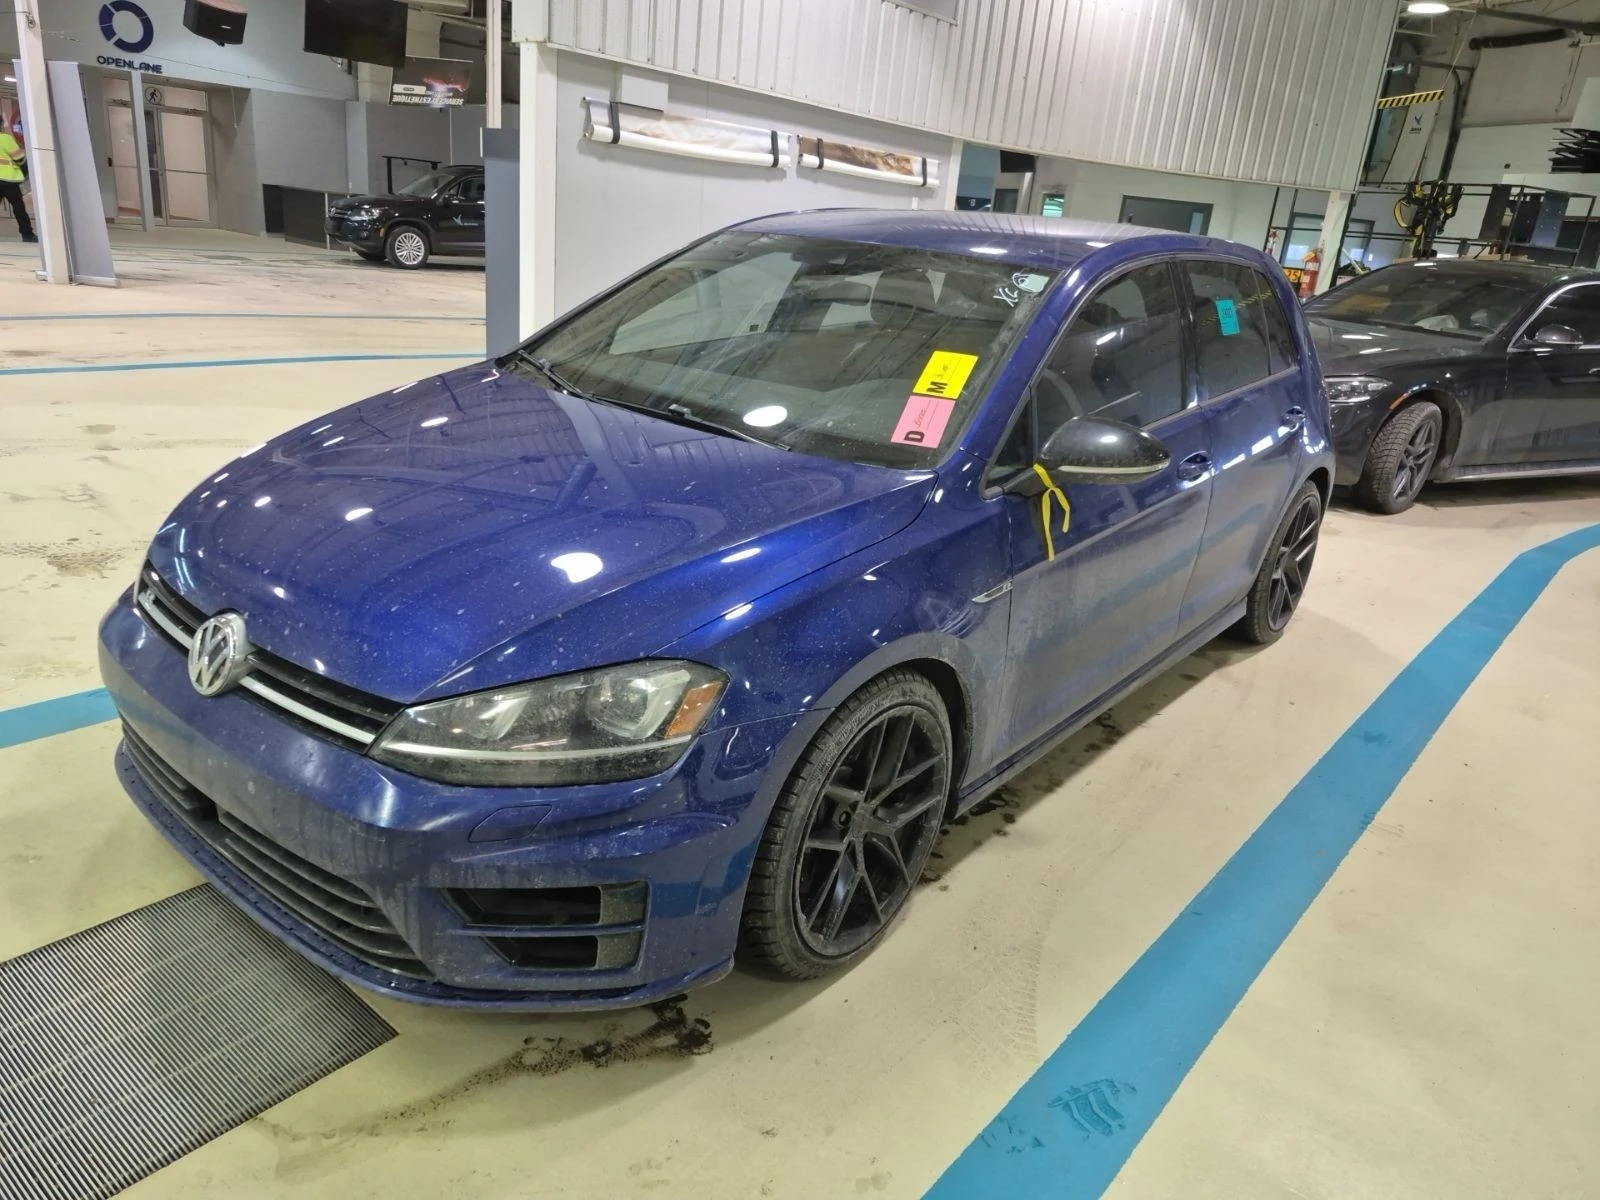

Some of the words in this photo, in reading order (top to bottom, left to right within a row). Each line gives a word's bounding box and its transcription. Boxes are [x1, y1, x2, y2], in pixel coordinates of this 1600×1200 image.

[97, 56, 163, 74] OPENLANE
[926, 380, 948, 394] M
[904, 430, 925, 443] D
